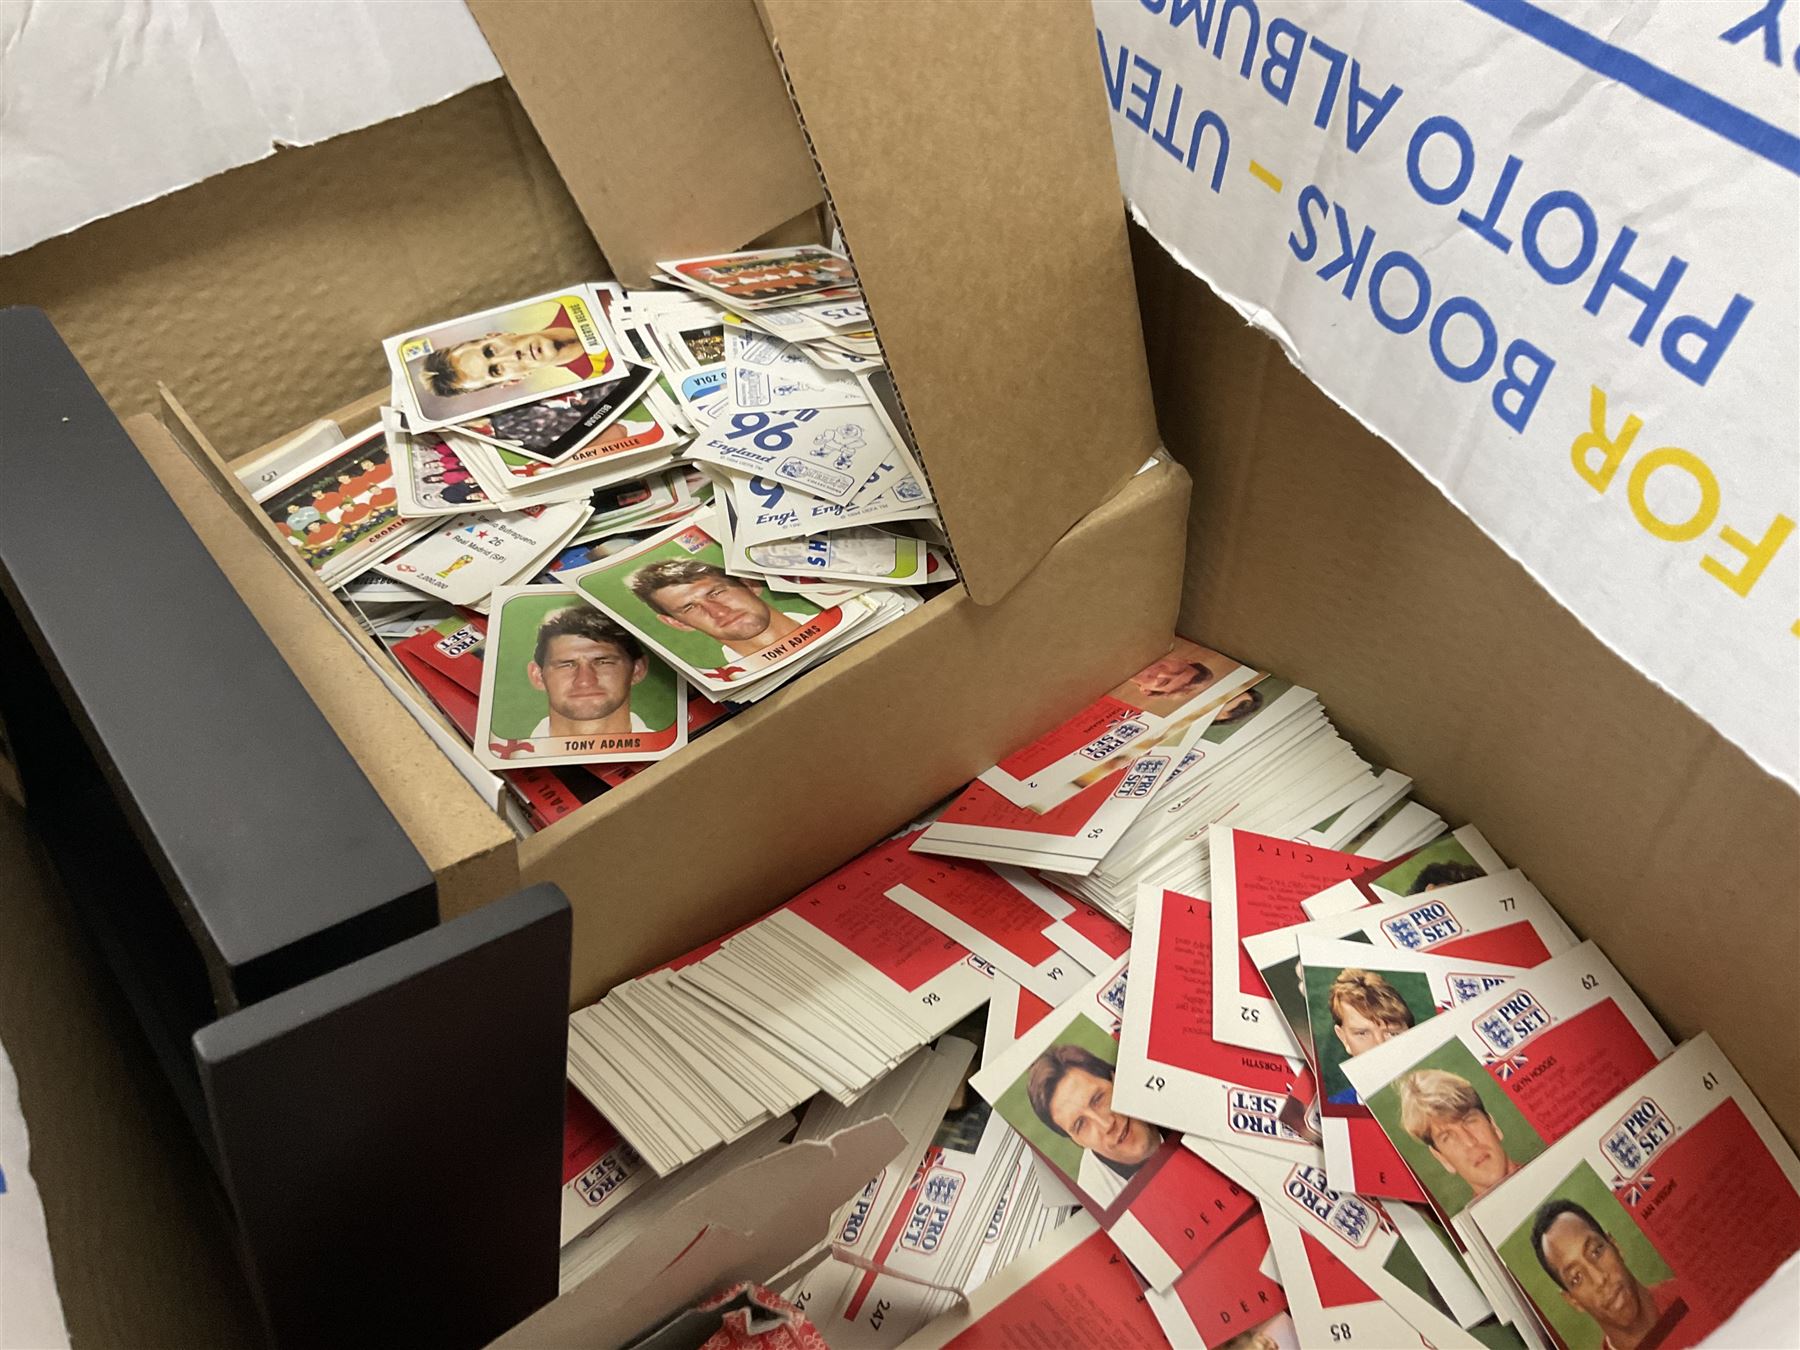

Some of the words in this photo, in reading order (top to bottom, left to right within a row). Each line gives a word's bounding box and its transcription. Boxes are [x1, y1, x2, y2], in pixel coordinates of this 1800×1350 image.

[1138, 0, 1403, 154] ALBUM
[1406, 115, 1754, 386] PHOTO
[1288, 184, 1556, 434] BOOKS
[694, 373, 718, 386] ZOLA
[725, 411, 798, 451] 96
[572, 449, 597, 461] GARY
[601, 438, 640, 454] NEVILLE
[707, 440, 776, 463] England
[1571, 384, 1796, 598] FOR
[368, 518, 408, 544] CROATIA
[488, 537, 504, 547] 26
[498, 524, 537, 546] Butragueno
[452, 535, 468, 547] Real
[469, 542, 491, 557] Madrid
[439, 628, 465, 650] SET
[449, 634, 480, 656] PRO
[762, 644, 788, 662] TONY
[788, 624, 822, 648] ADAMS
[565, 740, 596, 751] TONY
[600, 738, 641, 750] ADAMS
[1085, 734, 1114, 754] SET
[1093, 739, 1124, 759] PRO
[1119, 774, 1140, 796] SET
[1133, 774, 1157, 796] PRO
[1088, 828, 1103, 839] 95
[1409, 903, 1445, 926] PRO
[1499, 897, 1515, 912] 77
[1422, 918, 1457, 942] SET
[1047, 967, 1063, 981] 64
[1582, 974, 1599, 990] 62
[922, 992, 941, 1007] 86
[1498, 993, 1532, 1022] PRO
[1240, 1006, 1260, 1023] 52
[1513, 1009, 1546, 1039] SET
[1242, 1057, 1283, 1073] FORSYTH
[1144, 1075, 1166, 1092] 67
[1702, 1072, 1719, 1090] 61
[1233, 1093, 1276, 1114] SET
[1233, 1114, 1277, 1136] PRO
[1624, 1102, 1656, 1136] PRO
[1639, 1117, 1669, 1155] SET
[581, 1156, 616, 1192] SET
[589, 1167, 627, 1202] PRO
[1289, 1180, 1333, 1221] PRO
[842, 1201, 869, 1242] PRO
[905, 1203, 931, 1246] SET
[921, 1207, 948, 1250] PRO
[870, 1299, 891, 1331] 247
[1330, 1323, 1352, 1342] 85
